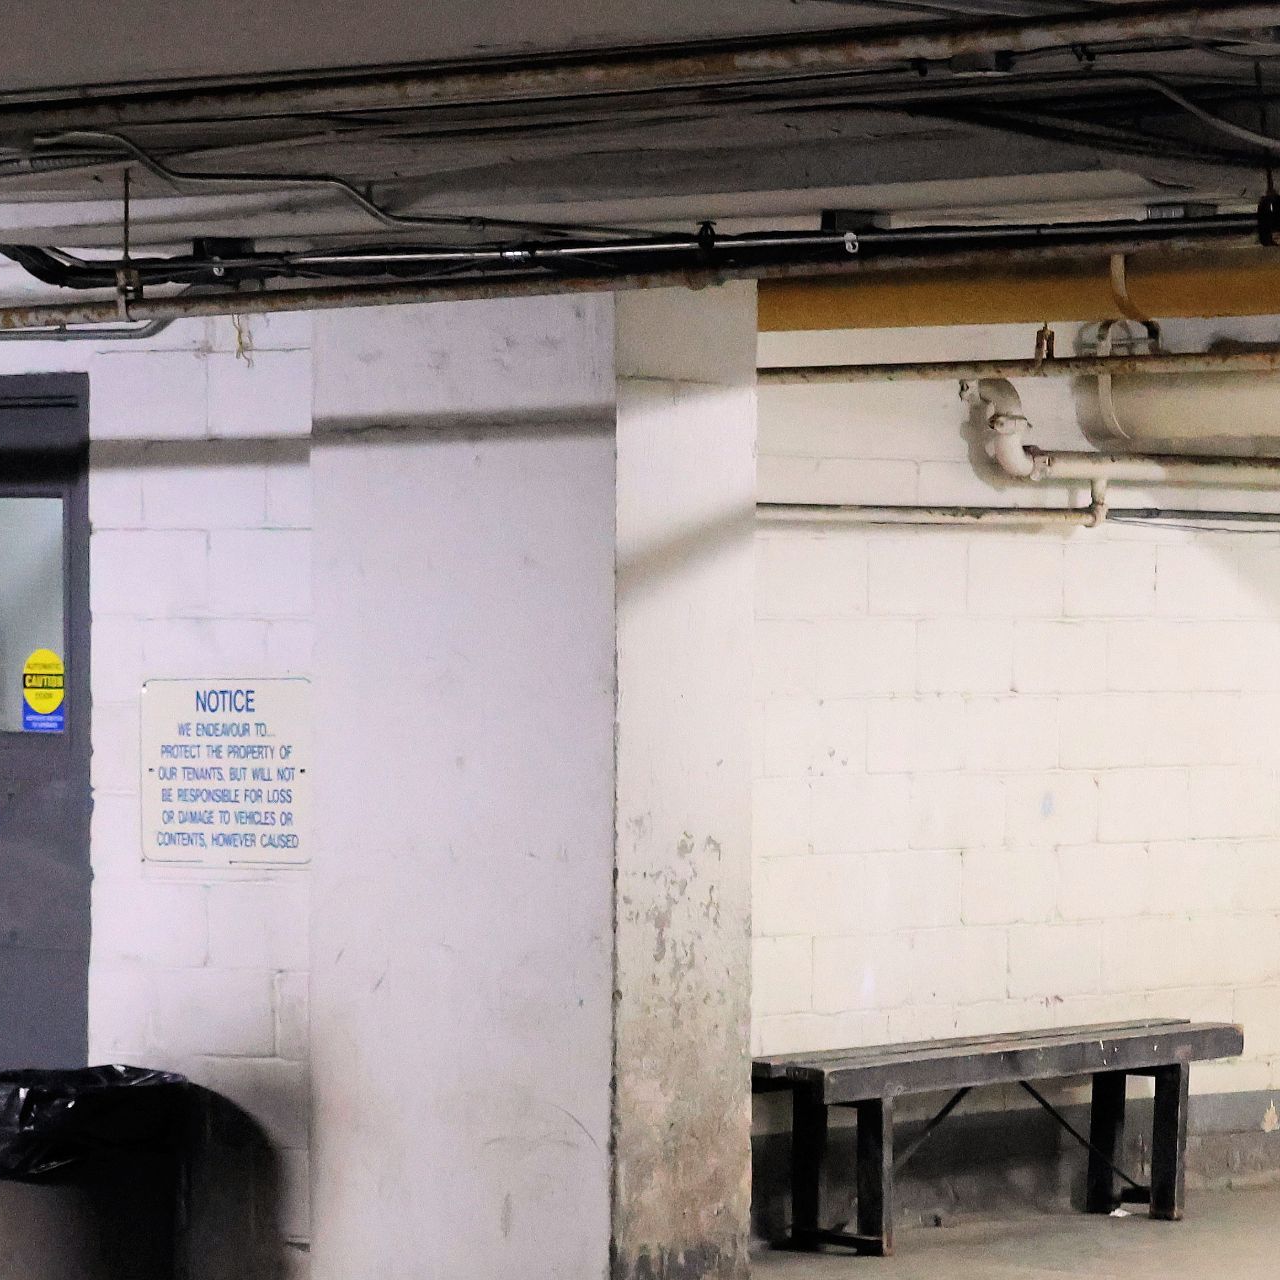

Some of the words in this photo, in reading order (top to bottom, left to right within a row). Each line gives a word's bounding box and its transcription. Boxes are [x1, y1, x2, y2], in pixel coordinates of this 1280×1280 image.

[195, 689, 255, 712] NOTICE
[178, 722, 191, 737] WE
[196, 722, 250, 737] ENDEAVOUR
[161, 744, 200, 759] PROTECT
[206, 744, 222, 759] THE
[227, 744, 275, 760] PROPERTY
[279, 744, 292, 760] OF
[158, 766, 177, 781] OUR
[229, 766, 247, 781] BUT
[252, 767, 272, 781] WILL
[277, 767, 296, 781] NOT
[161, 788, 173, 802] BE
[177, 788, 240, 803] RESPONSIBLE
[244, 788, 263, 803] FOR
[267, 788, 292, 803] LOSS
[162, 810, 175, 824] OR
[178, 810, 214, 825] DAMAGE
[218, 810, 231, 825] TO
[234, 811, 276, 826] VEHICLES
[280, 811, 294, 826] OR
[211, 832, 257, 848] HOWEVER
[260, 833, 300, 848] CAUSED
